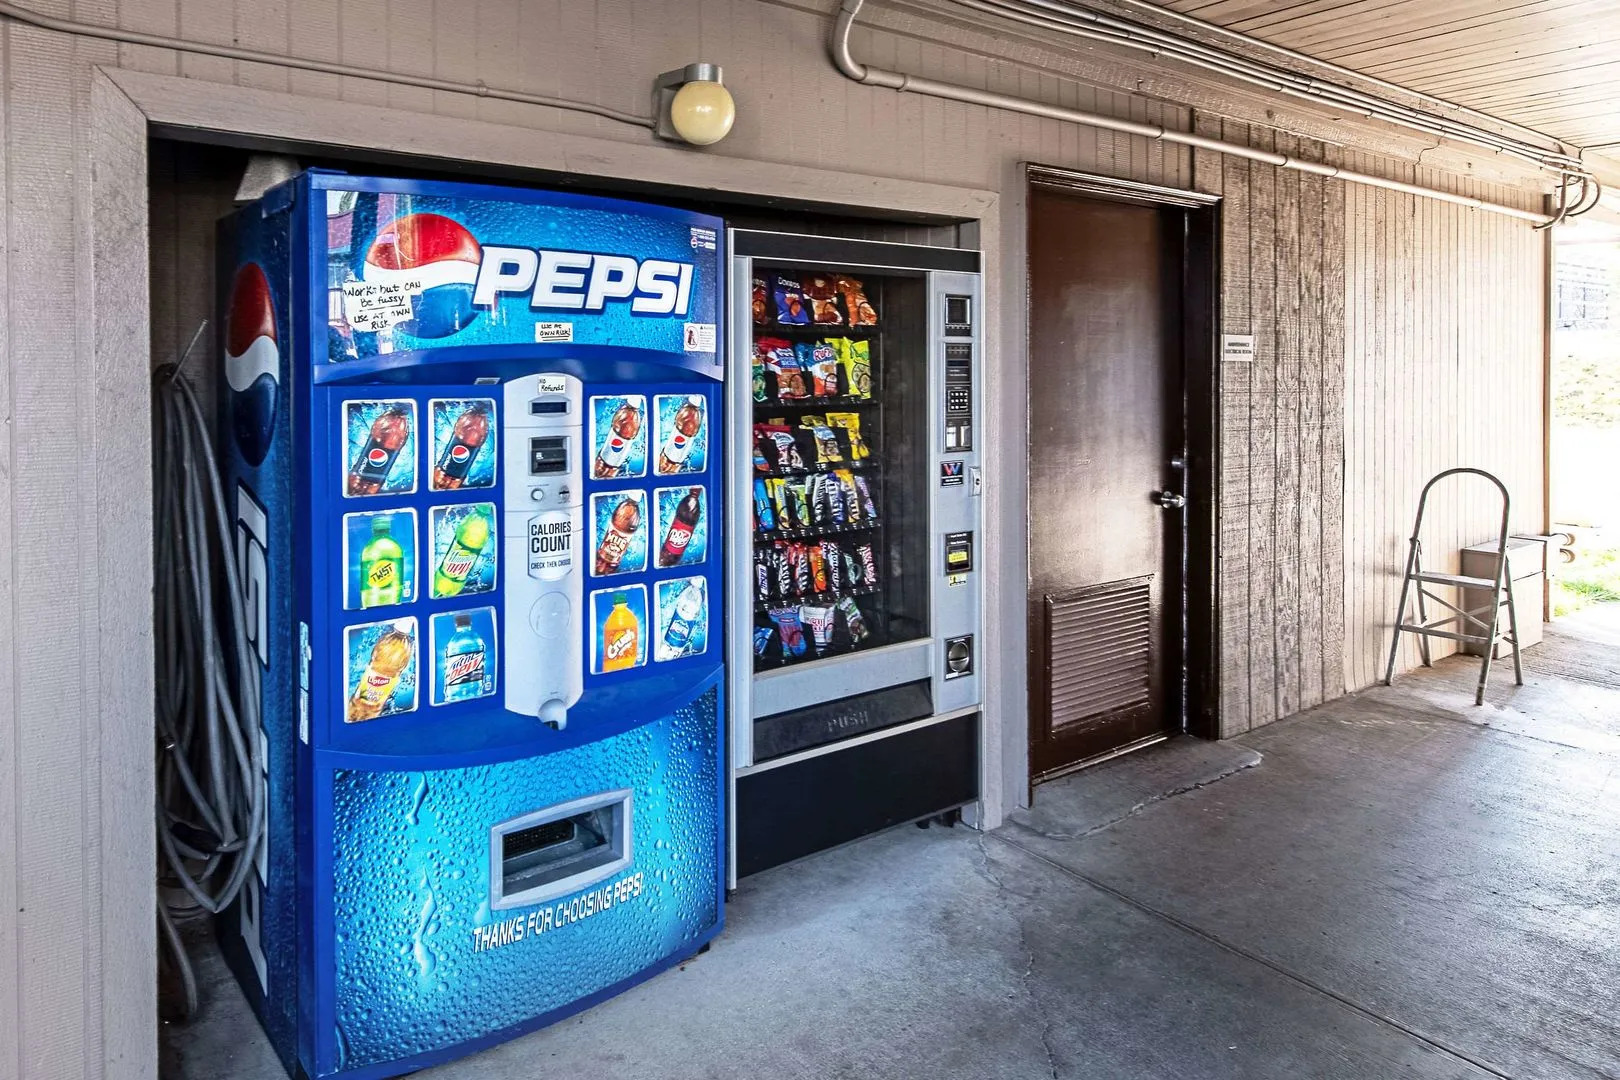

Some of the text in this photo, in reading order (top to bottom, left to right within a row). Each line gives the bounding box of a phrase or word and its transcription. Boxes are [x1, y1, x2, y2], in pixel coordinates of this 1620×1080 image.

[380, 284, 400, 294] but
[404, 281, 421, 290] CAN
[472, 246, 694, 315] PEPSI
[378, 296, 405, 306] fussy
[531, 521, 571, 536] CALORIES
[531, 534, 571, 554] COUNT
[531, 562, 545, 570] CHECK
[546, 560, 557, 568] THEN
[368, 677, 390, 686] Lipton
[472, 872, 644, 954] THANKS FOR CHOOSING PEPSI
